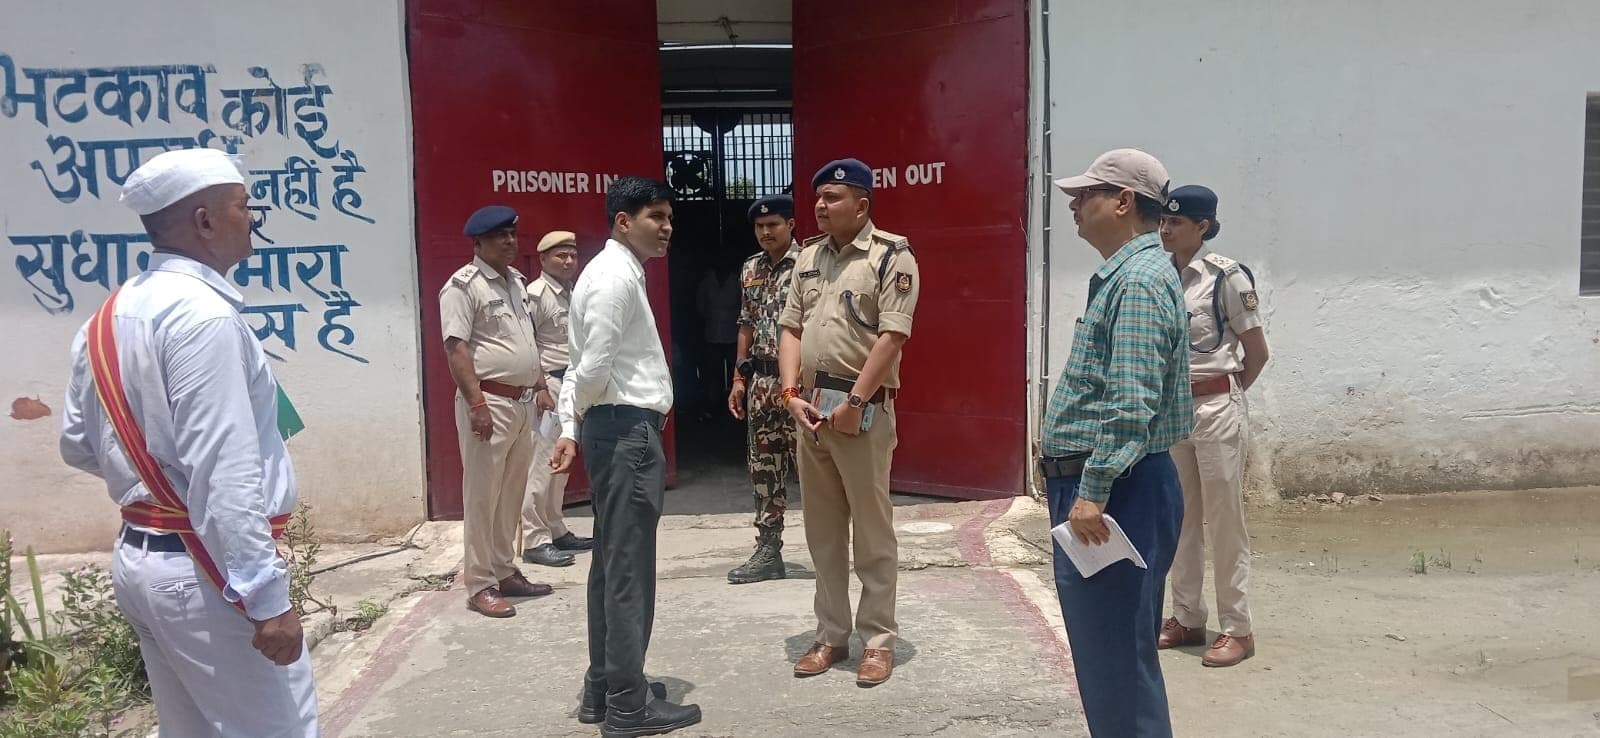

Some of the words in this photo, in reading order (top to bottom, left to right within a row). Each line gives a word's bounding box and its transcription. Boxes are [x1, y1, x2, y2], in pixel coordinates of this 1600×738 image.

[0, 54, 217, 128] भटकाव
[220, 64, 340, 159] कोई
[249, 156, 322, 221] नहीं
[331, 150, 375, 225] है
[492, 169, 589, 194] PRISONER
[872, 167, 897, 189] EN
[905, 161, 946, 186] OUT
[233, 245, 349, 300] मारा
[317, 290, 370, 364] है
